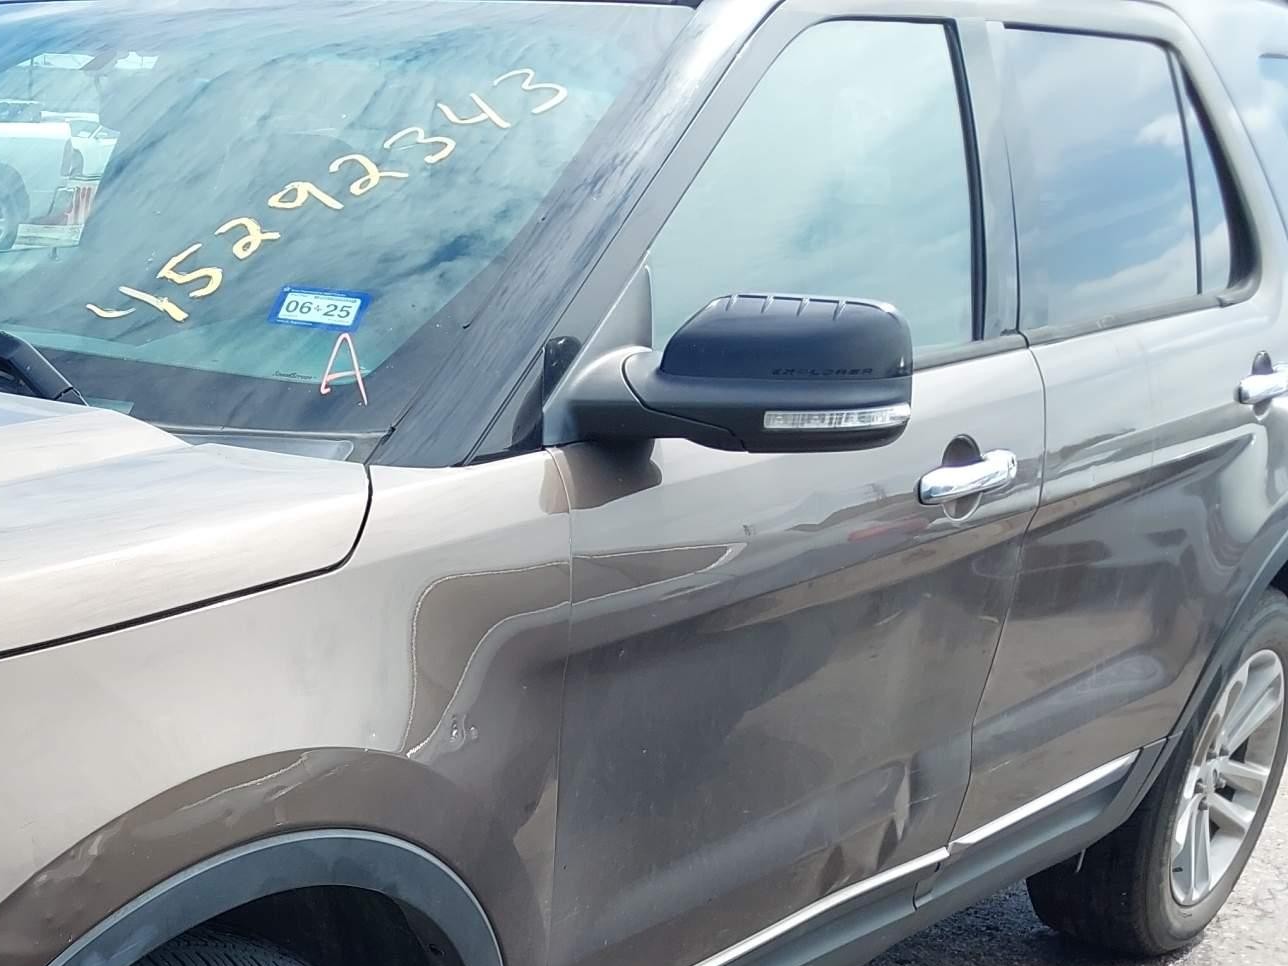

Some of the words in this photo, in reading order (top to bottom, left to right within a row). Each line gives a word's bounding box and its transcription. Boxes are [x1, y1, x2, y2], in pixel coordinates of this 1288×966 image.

[85, 67, 569, 323] 45292343
[285, 299, 314, 315] 06
[322, 304, 353, 319] 25
[320, 332, 371, 406] A
